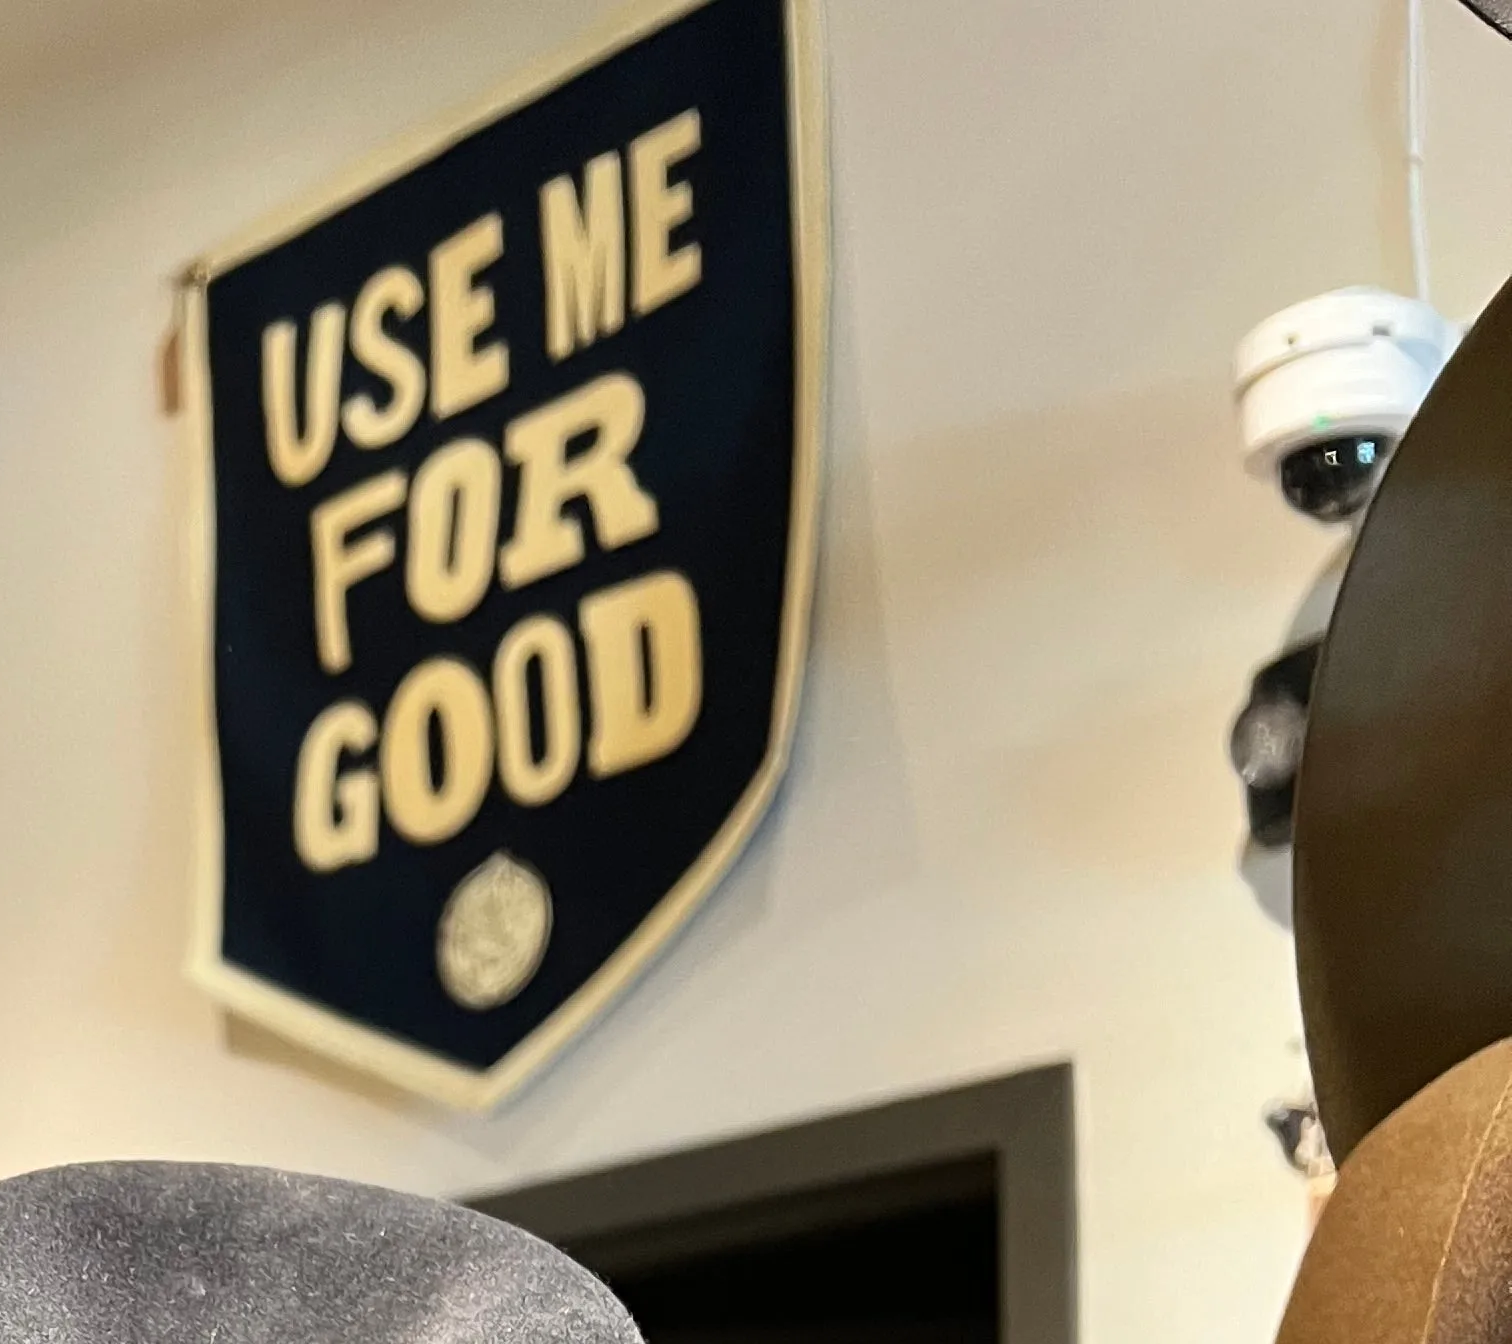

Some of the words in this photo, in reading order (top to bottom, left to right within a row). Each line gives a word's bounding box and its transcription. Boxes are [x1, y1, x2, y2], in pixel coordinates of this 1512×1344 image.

[261, 213, 509, 486] USE
[539, 108, 703, 362] ME
[311, 372, 659, 674] FOR
[294, 570, 703, 873] GOOD
